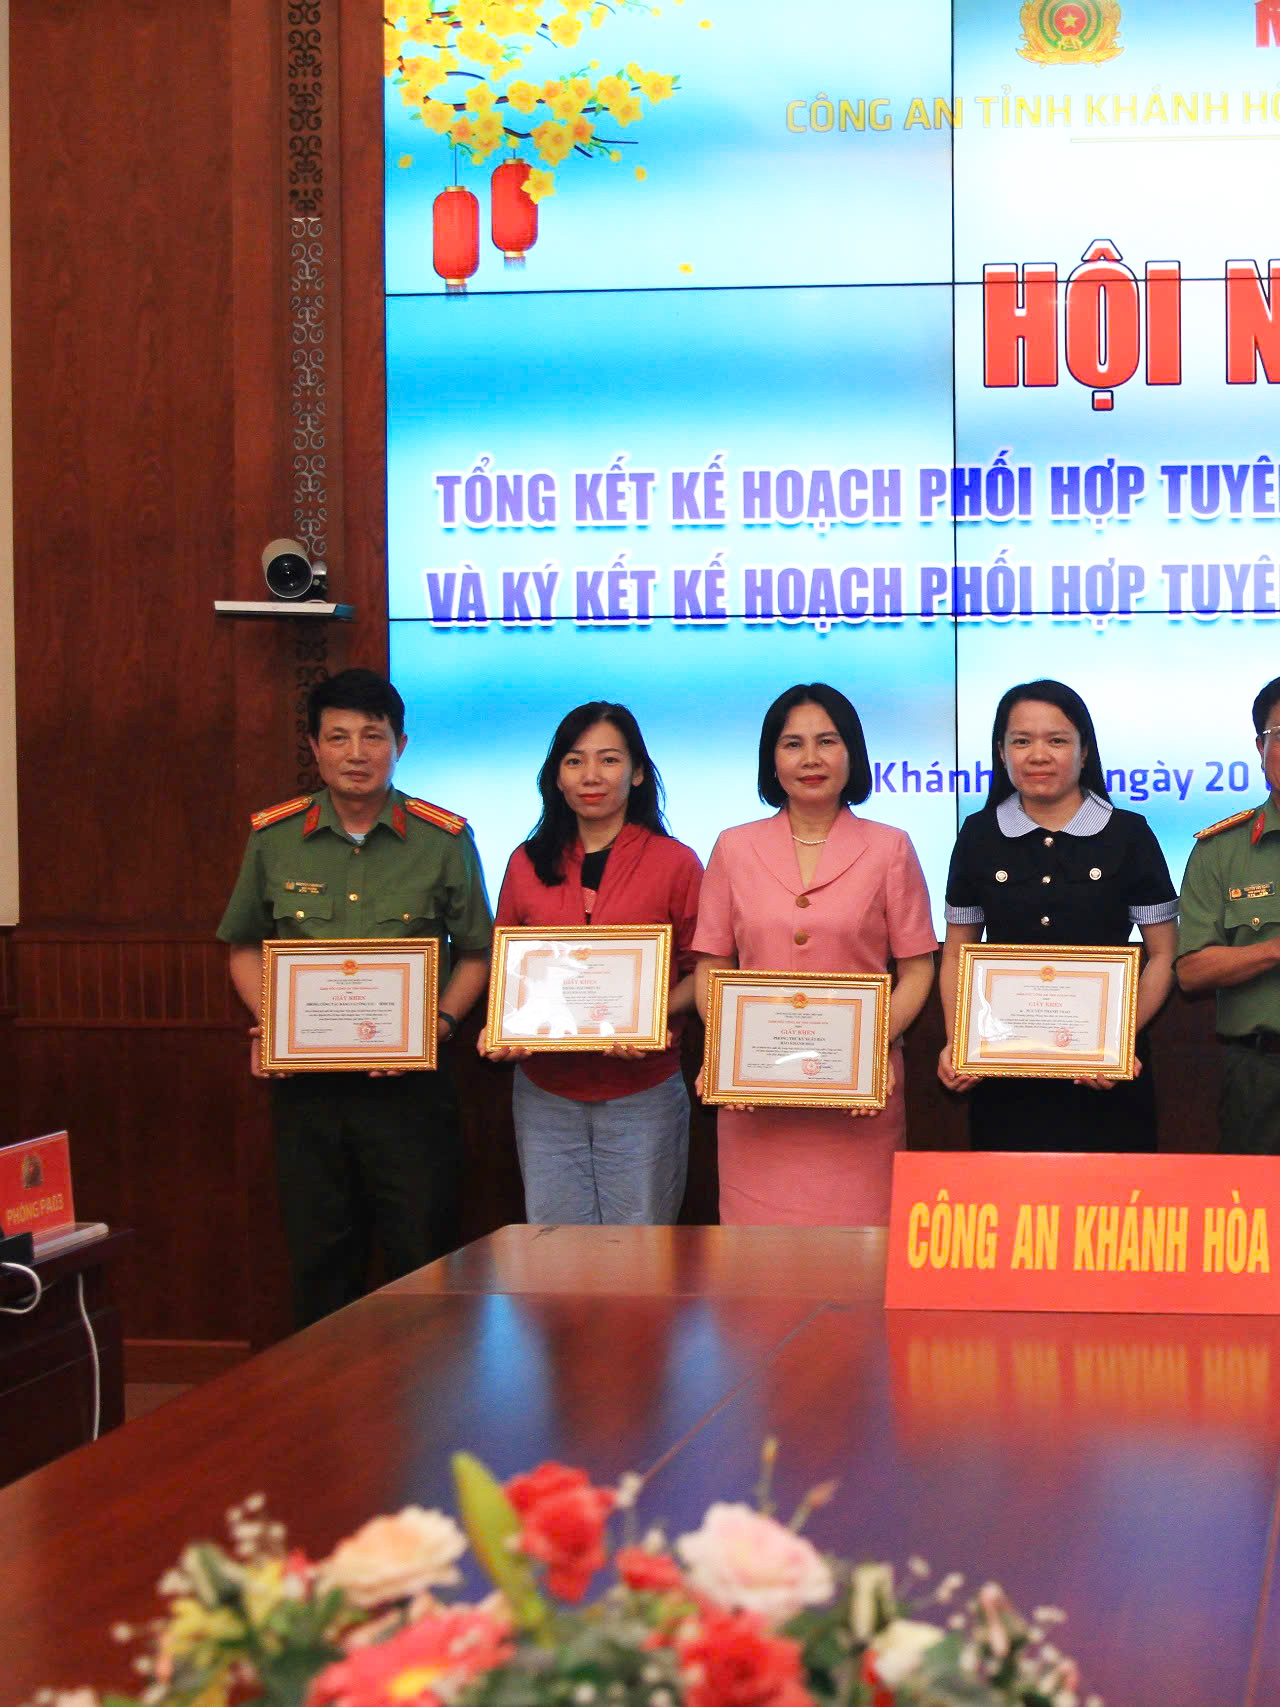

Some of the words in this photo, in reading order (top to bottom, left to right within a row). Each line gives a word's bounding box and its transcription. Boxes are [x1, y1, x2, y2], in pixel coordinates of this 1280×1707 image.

[786, 92, 892, 132] CÔNG
[904, 97, 964, 131] AN
[975, 84, 1072, 128] TỈNH
[1085, 85, 1229, 126] KHÁNH
[982, 238, 1182, 411] HỘI
[436, 456, 556, 523] TỔNG
[574, 455, 655, 521] KẾT
[672, 454, 726, 521] KẾ
[743, 468, 900, 530] HOẠCH
[919, 449, 1031, 517] PHỐI
[1050, 458, 1146, 525] HỢP
[427, 564, 488, 621] VÀ
[502, 563, 559, 621] KÝ
[576, 553, 656, 620] KẾT
[673, 552, 727, 620] KẾ
[744, 566, 902, 629] HOẠCH
[920, 549, 1032, 617] PHỐI
[1052, 557, 1146, 625] HỢP
[874, 760, 993, 793] Khánh
[1106, 760, 1194, 801] ngày
[1205, 760, 1250, 792] 20
[907, 1189, 999, 1270] CÔNG
[1010, 1203, 1060, 1271] AN
[1073, 1189, 1189, 1272] KHÁNH
[1201, 1189, 1271, 1274] HÒA
